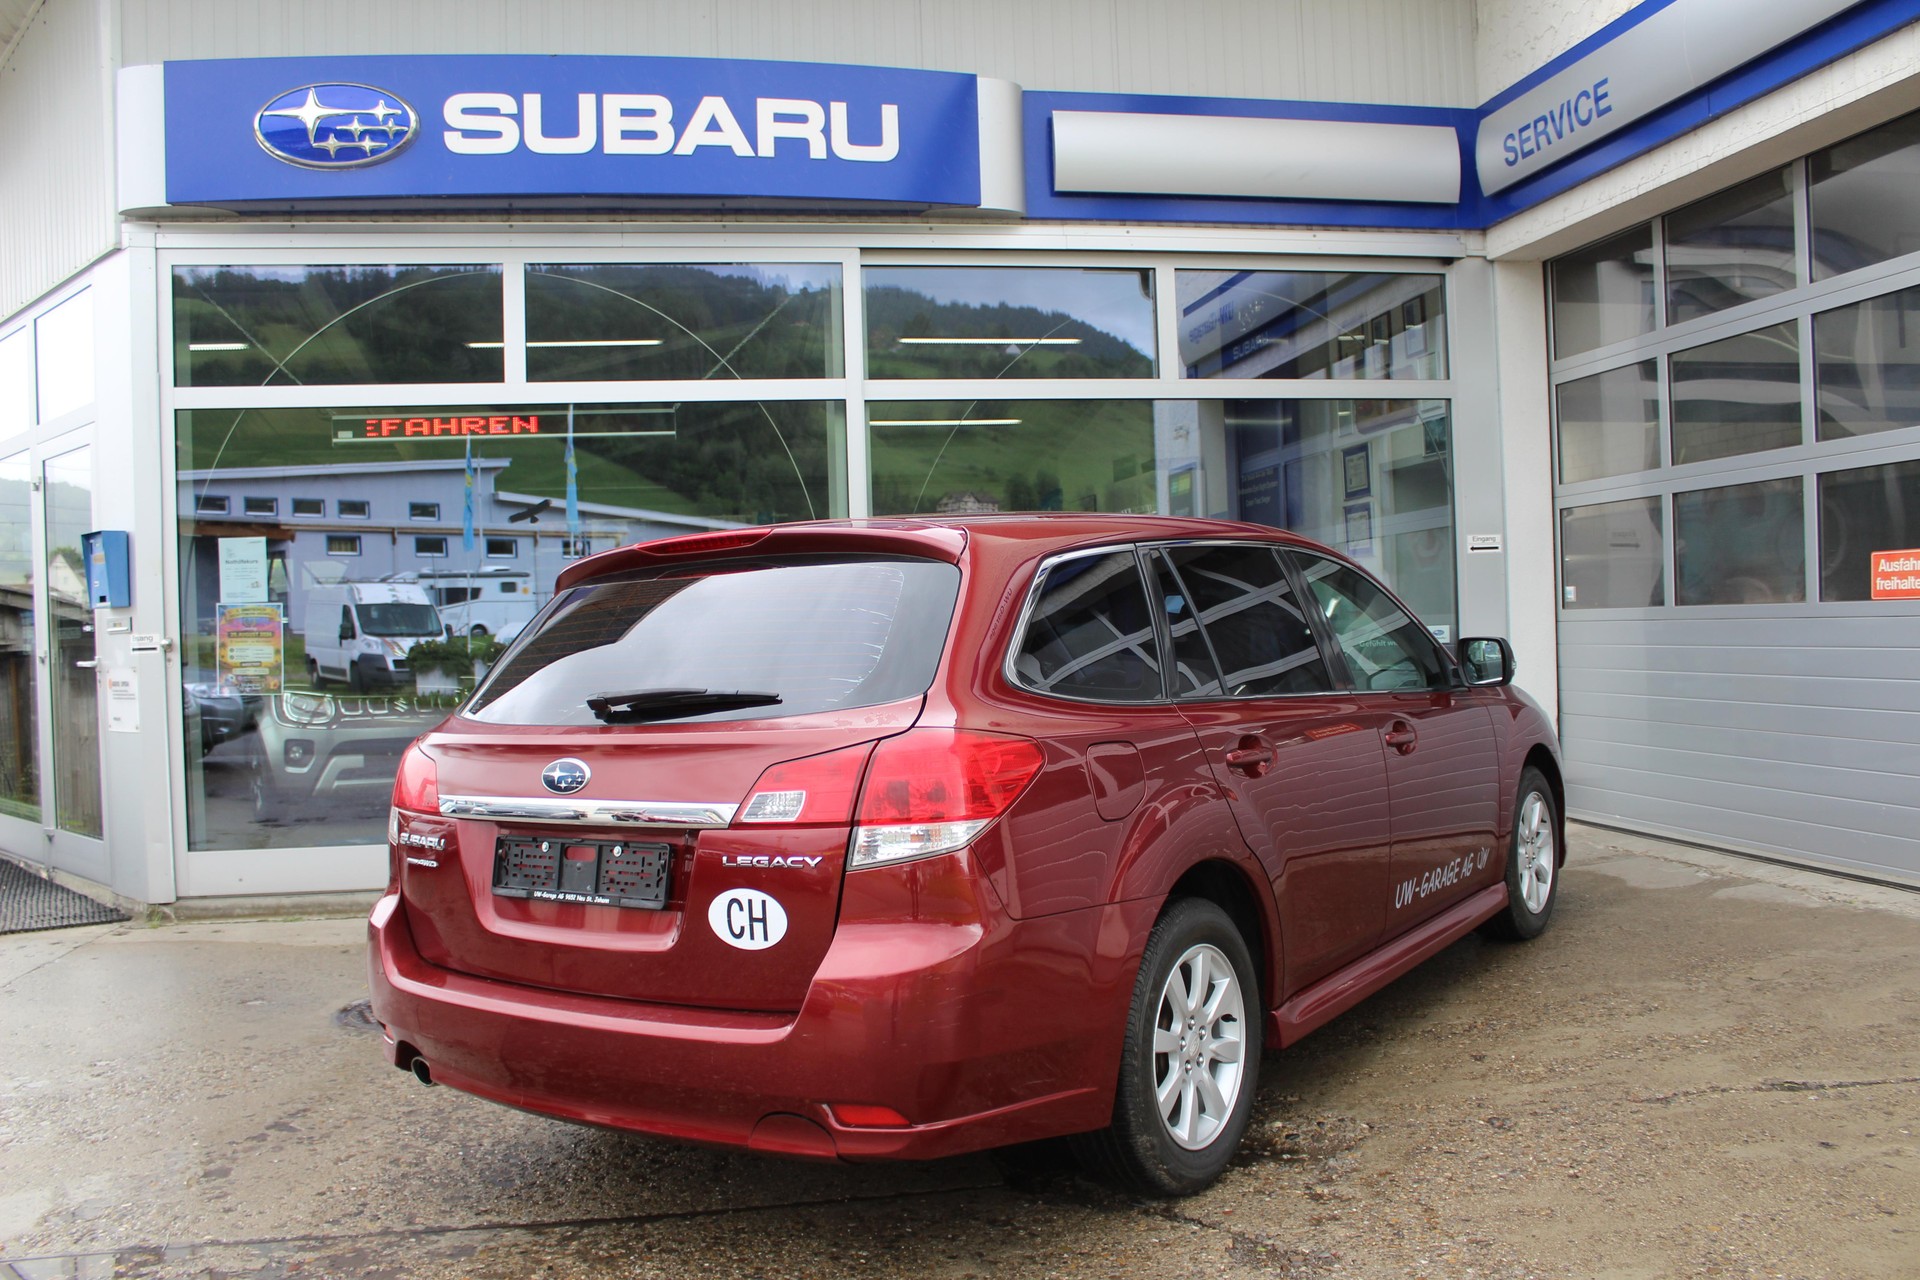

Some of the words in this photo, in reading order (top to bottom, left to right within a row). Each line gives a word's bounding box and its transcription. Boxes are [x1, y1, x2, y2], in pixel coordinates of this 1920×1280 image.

[443, 92, 900, 162] SUBARU
[1503, 77, 1613, 167] SERVICE
[1472, 535, 1497, 543] Eingang
[400, 832, 446, 851] SUBARU
[722, 855, 823, 869] LEGACY
[1395, 857, 1461, 909] UW-GARAGE
[1461, 852, 1474, 879] AG
[726, 897, 769, 942] CH
